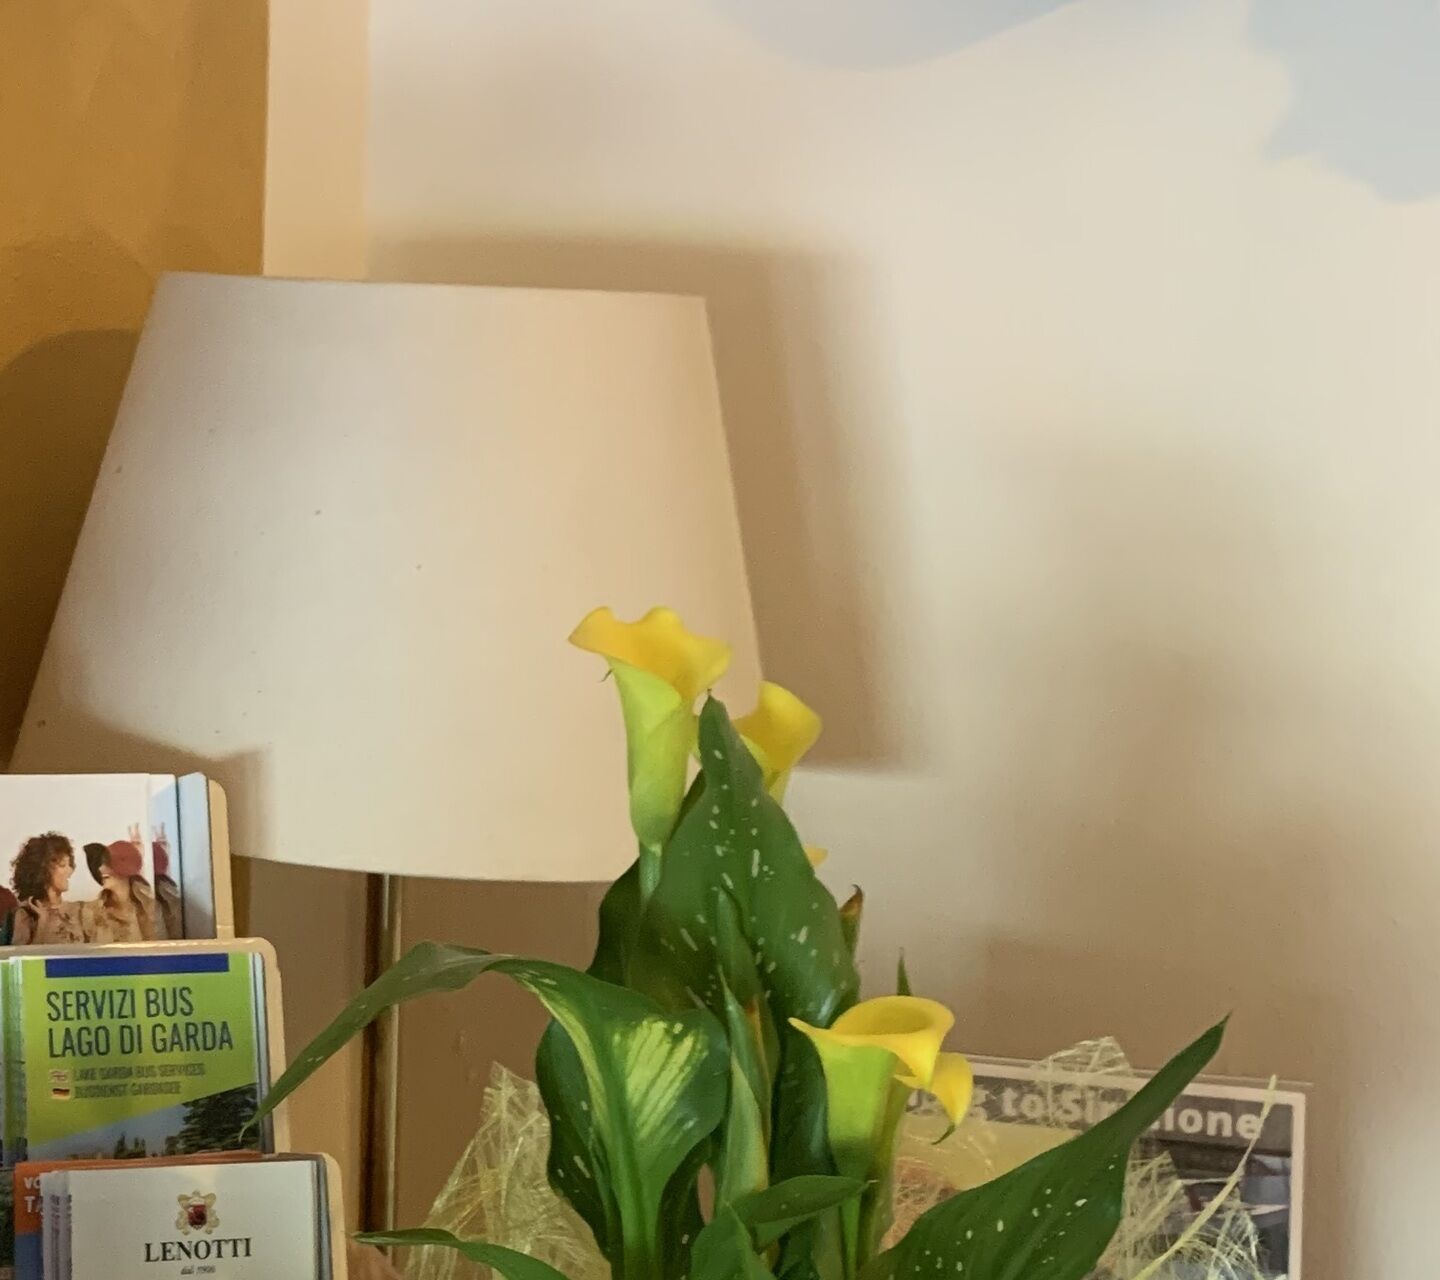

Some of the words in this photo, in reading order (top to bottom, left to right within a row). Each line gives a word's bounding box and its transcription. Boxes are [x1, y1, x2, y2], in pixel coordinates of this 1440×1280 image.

[46, 988, 136, 1021] SERVIZI
[145, 986, 194, 1018] BUS
[48, 1025, 110, 1058] LAGO
[120, 1024, 143, 1054] DI
[152, 1021, 233, 1053] GARDA
[144, 1237, 252, 1263] LENOTTI
